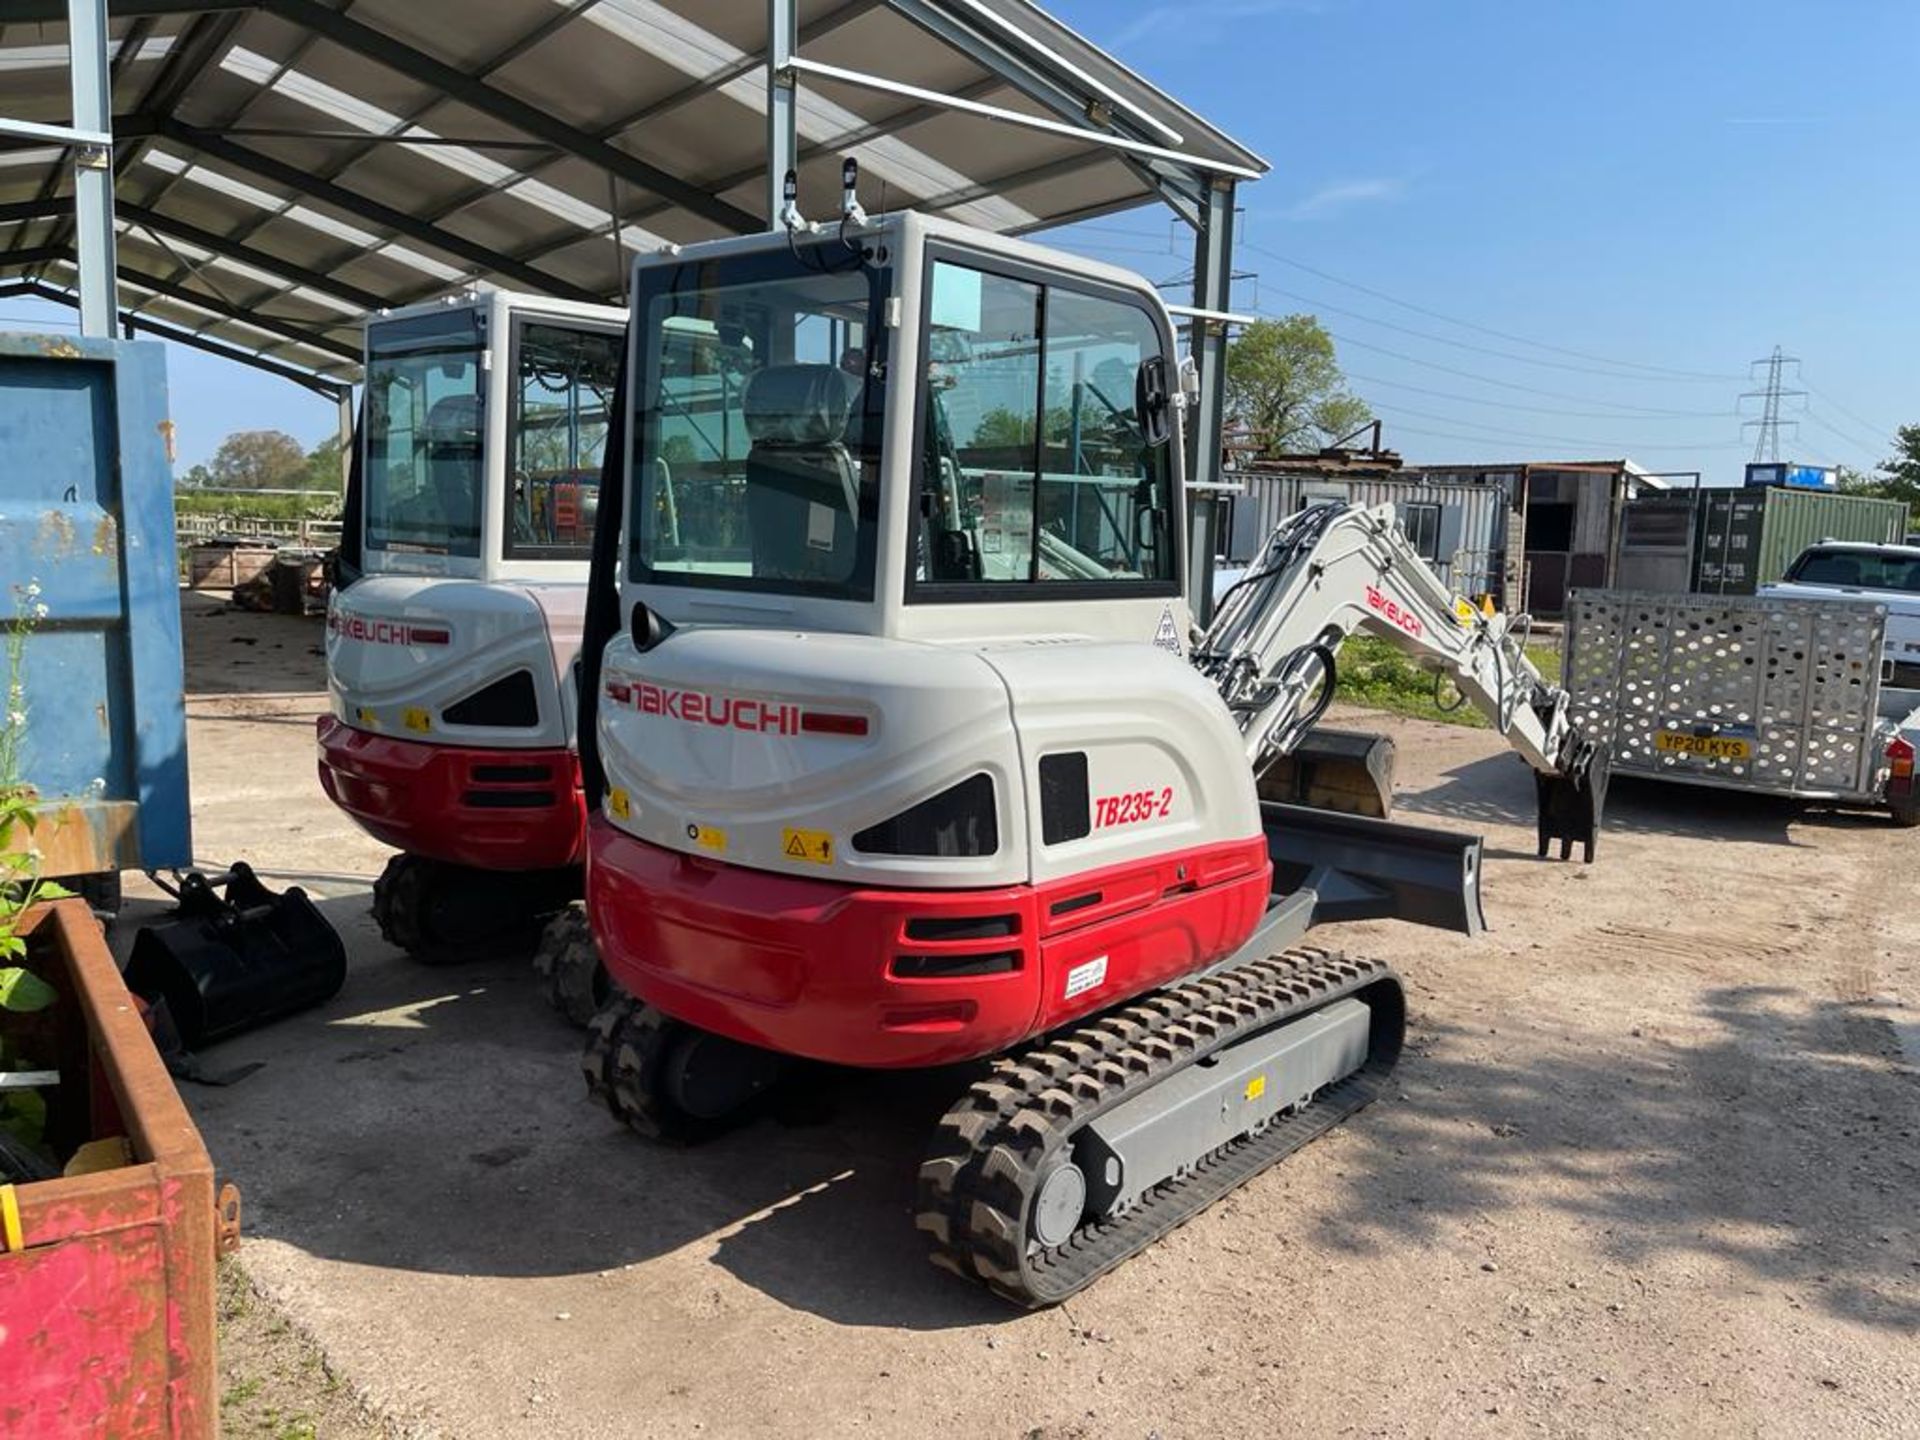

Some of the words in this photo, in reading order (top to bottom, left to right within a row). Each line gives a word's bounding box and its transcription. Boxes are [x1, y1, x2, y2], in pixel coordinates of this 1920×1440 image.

[1664, 733, 1706, 753] YP20
[1709, 741, 1743, 757] KYS
[1095, 786, 1174, 829] TB235-2
